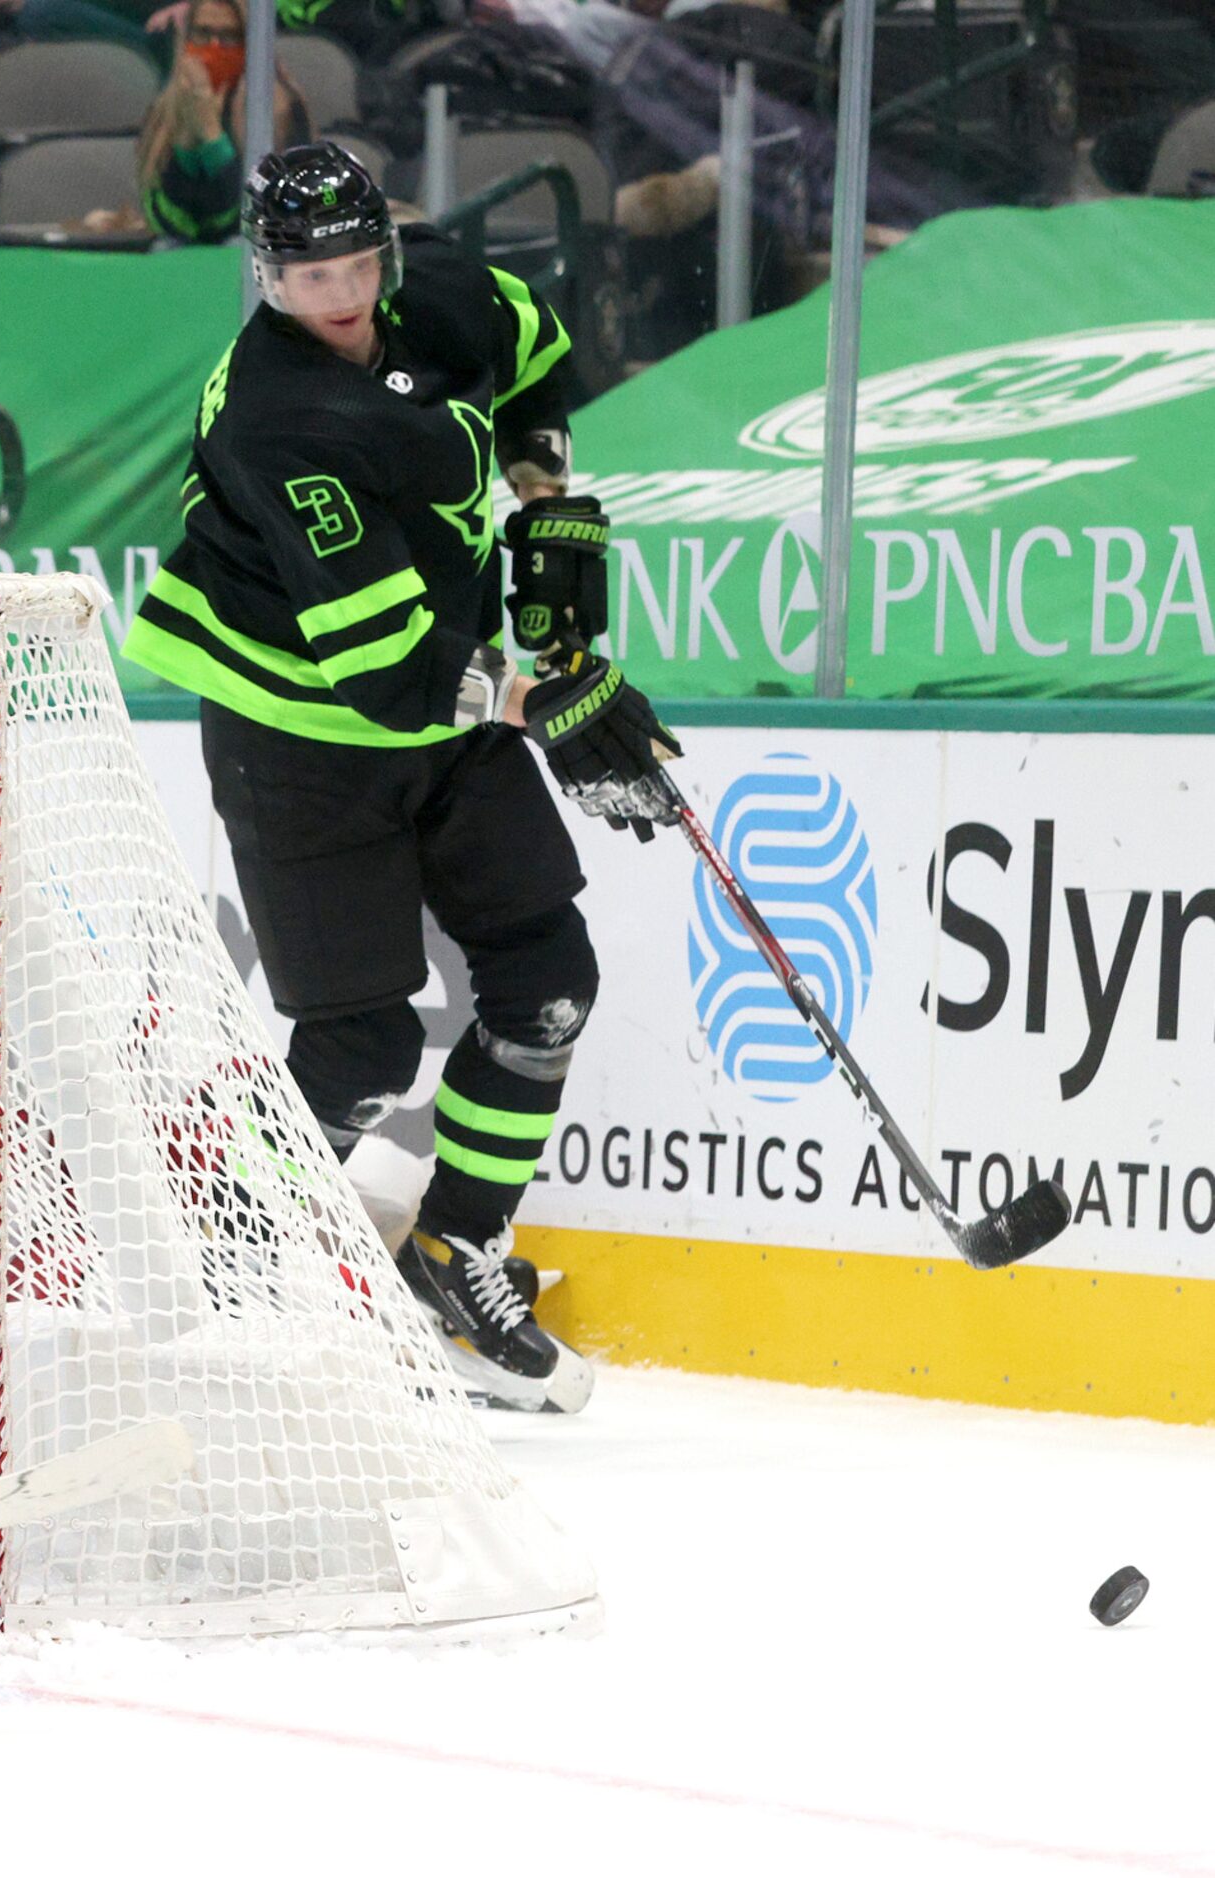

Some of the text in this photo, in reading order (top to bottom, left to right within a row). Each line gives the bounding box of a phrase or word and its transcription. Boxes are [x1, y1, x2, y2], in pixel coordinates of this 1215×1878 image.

[312, 217, 361, 239] CCM
[285, 474, 364, 558] 3
[532, 552, 544, 574] 3
[532, 1123, 823, 1203] OGISTICS
